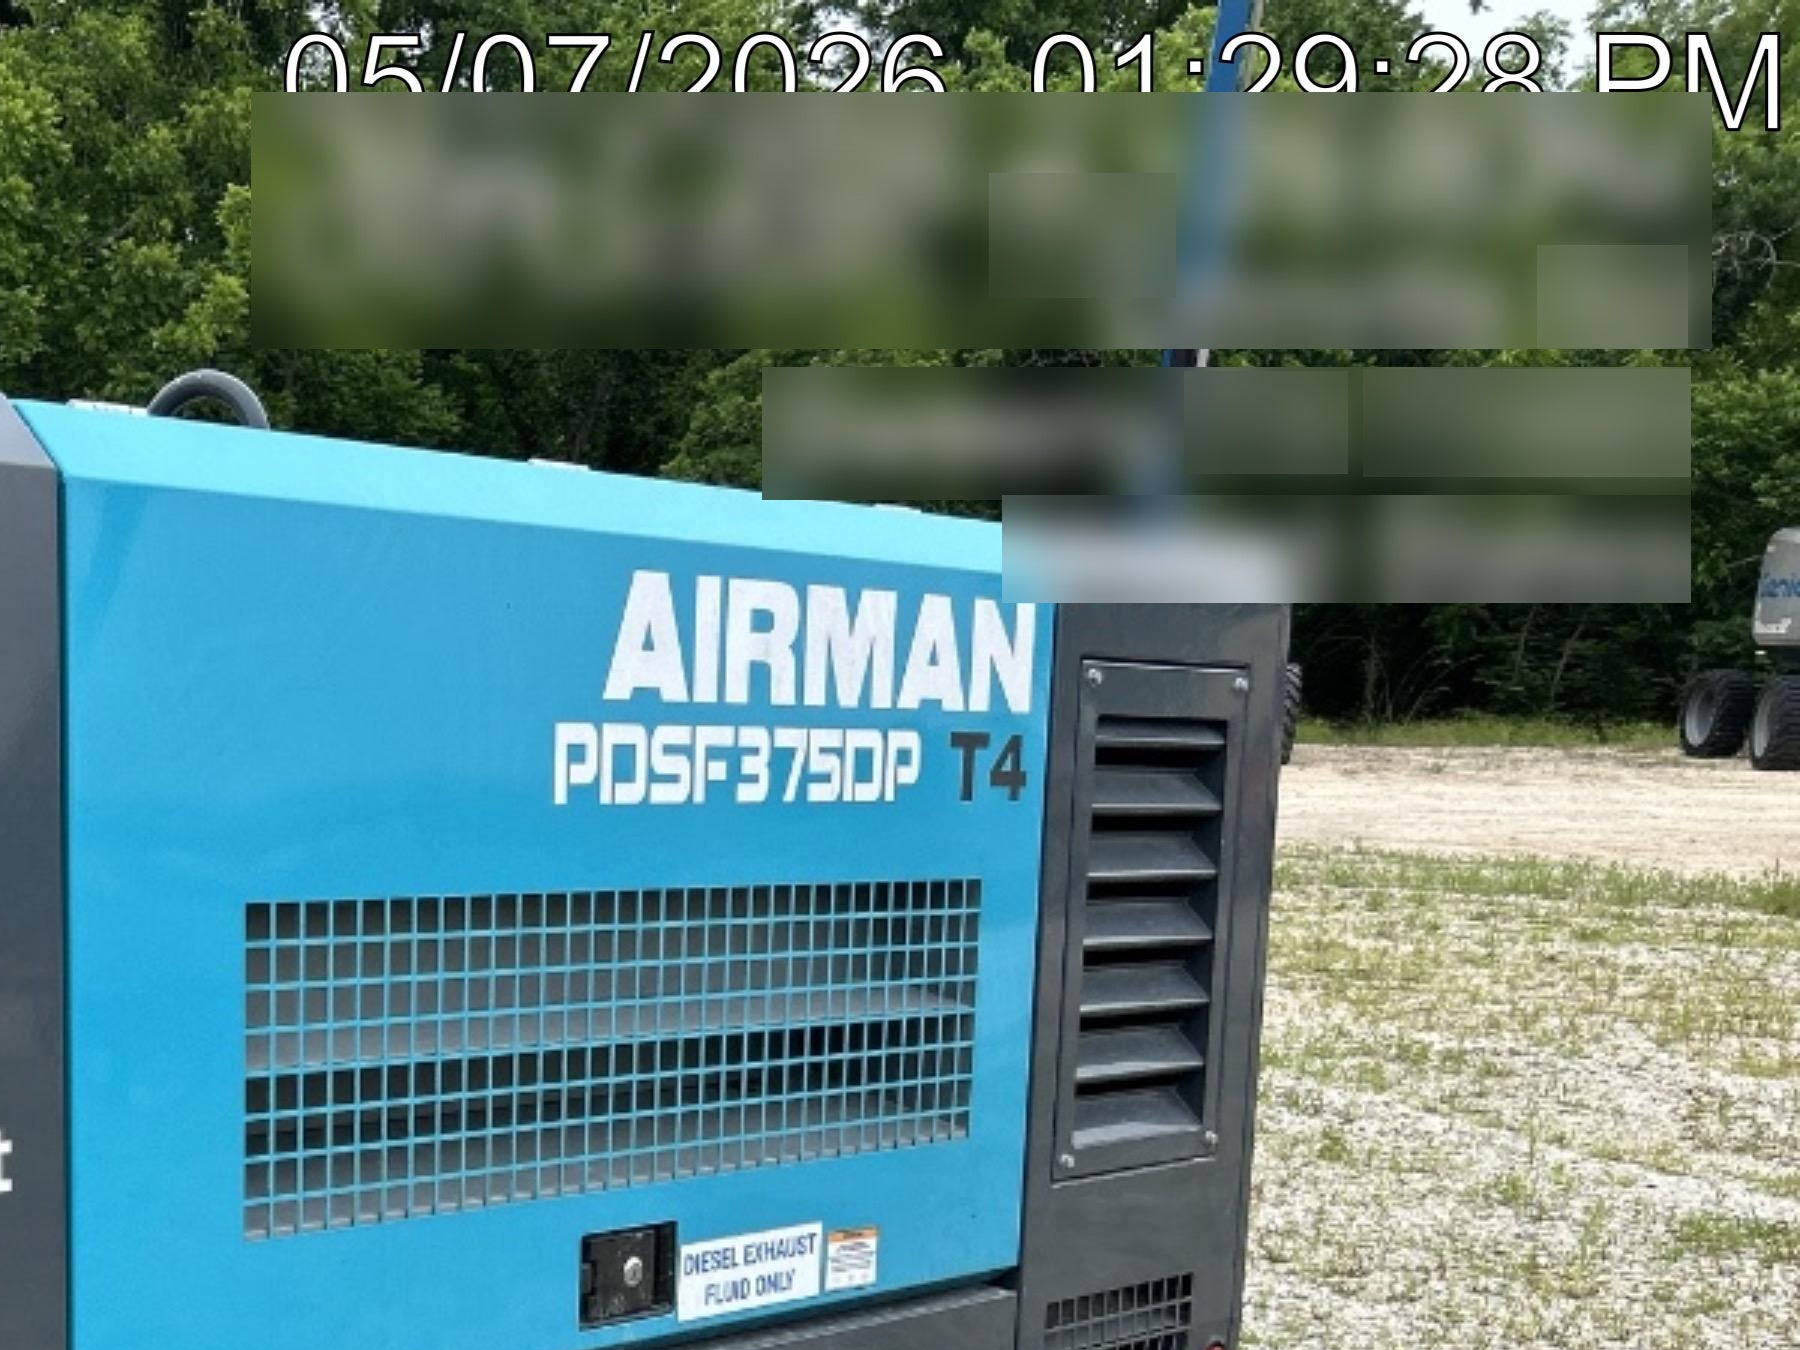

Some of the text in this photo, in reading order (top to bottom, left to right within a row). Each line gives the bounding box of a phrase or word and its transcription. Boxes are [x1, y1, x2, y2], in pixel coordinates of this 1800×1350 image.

[603, 569, 1037, 715] AIRMAN
[554, 722, 1028, 806] PDSF375DP T4
[683, 1246, 740, 1278] DIESEL
[743, 1231, 818, 1268] EXHAUST
[704, 1267, 797, 1307] FLUID ONLY
